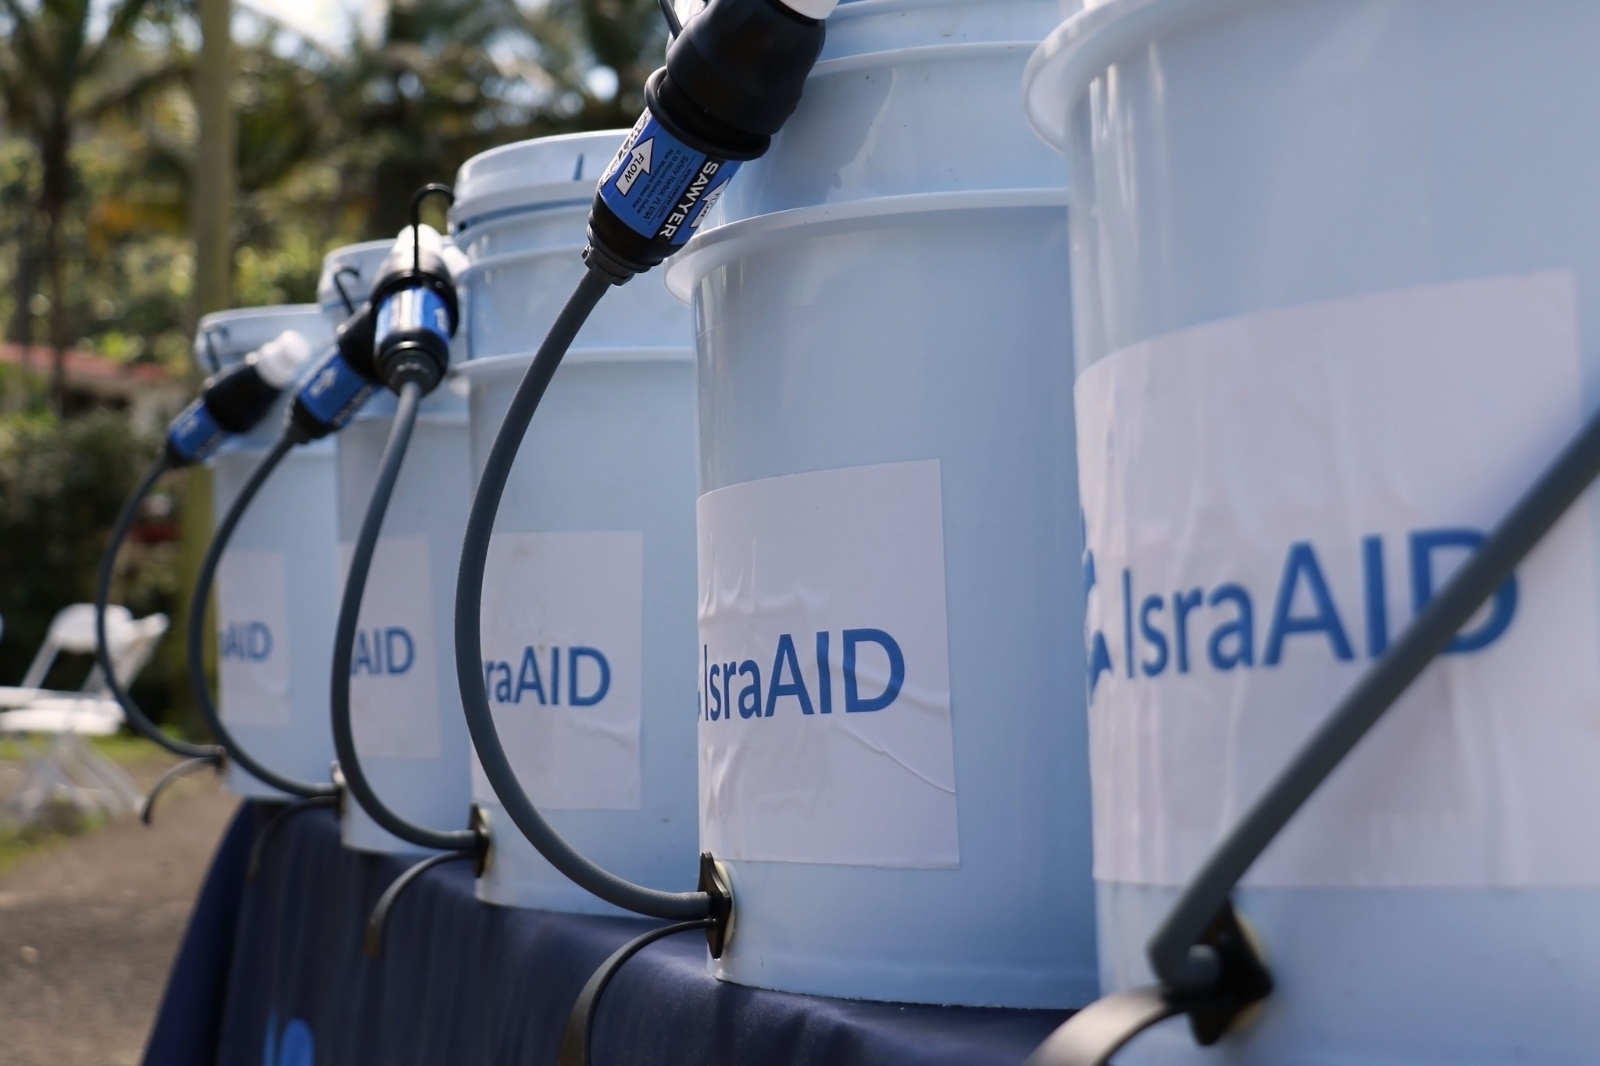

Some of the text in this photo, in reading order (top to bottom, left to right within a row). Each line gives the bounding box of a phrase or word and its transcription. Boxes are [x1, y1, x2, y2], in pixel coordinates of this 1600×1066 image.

[624, 152, 645, 183] FLOW
[673, 155, 689, 176] Safety
[643, 205, 656, 219] USA
[653, 197, 662, 206] FL
[656, 168, 693, 218] www.sawyer.com
[658, 161, 719, 238] SAWYER
[1122, 527, 1519, 679] IsraAID
[704, 628, 905, 721] IsraAID
